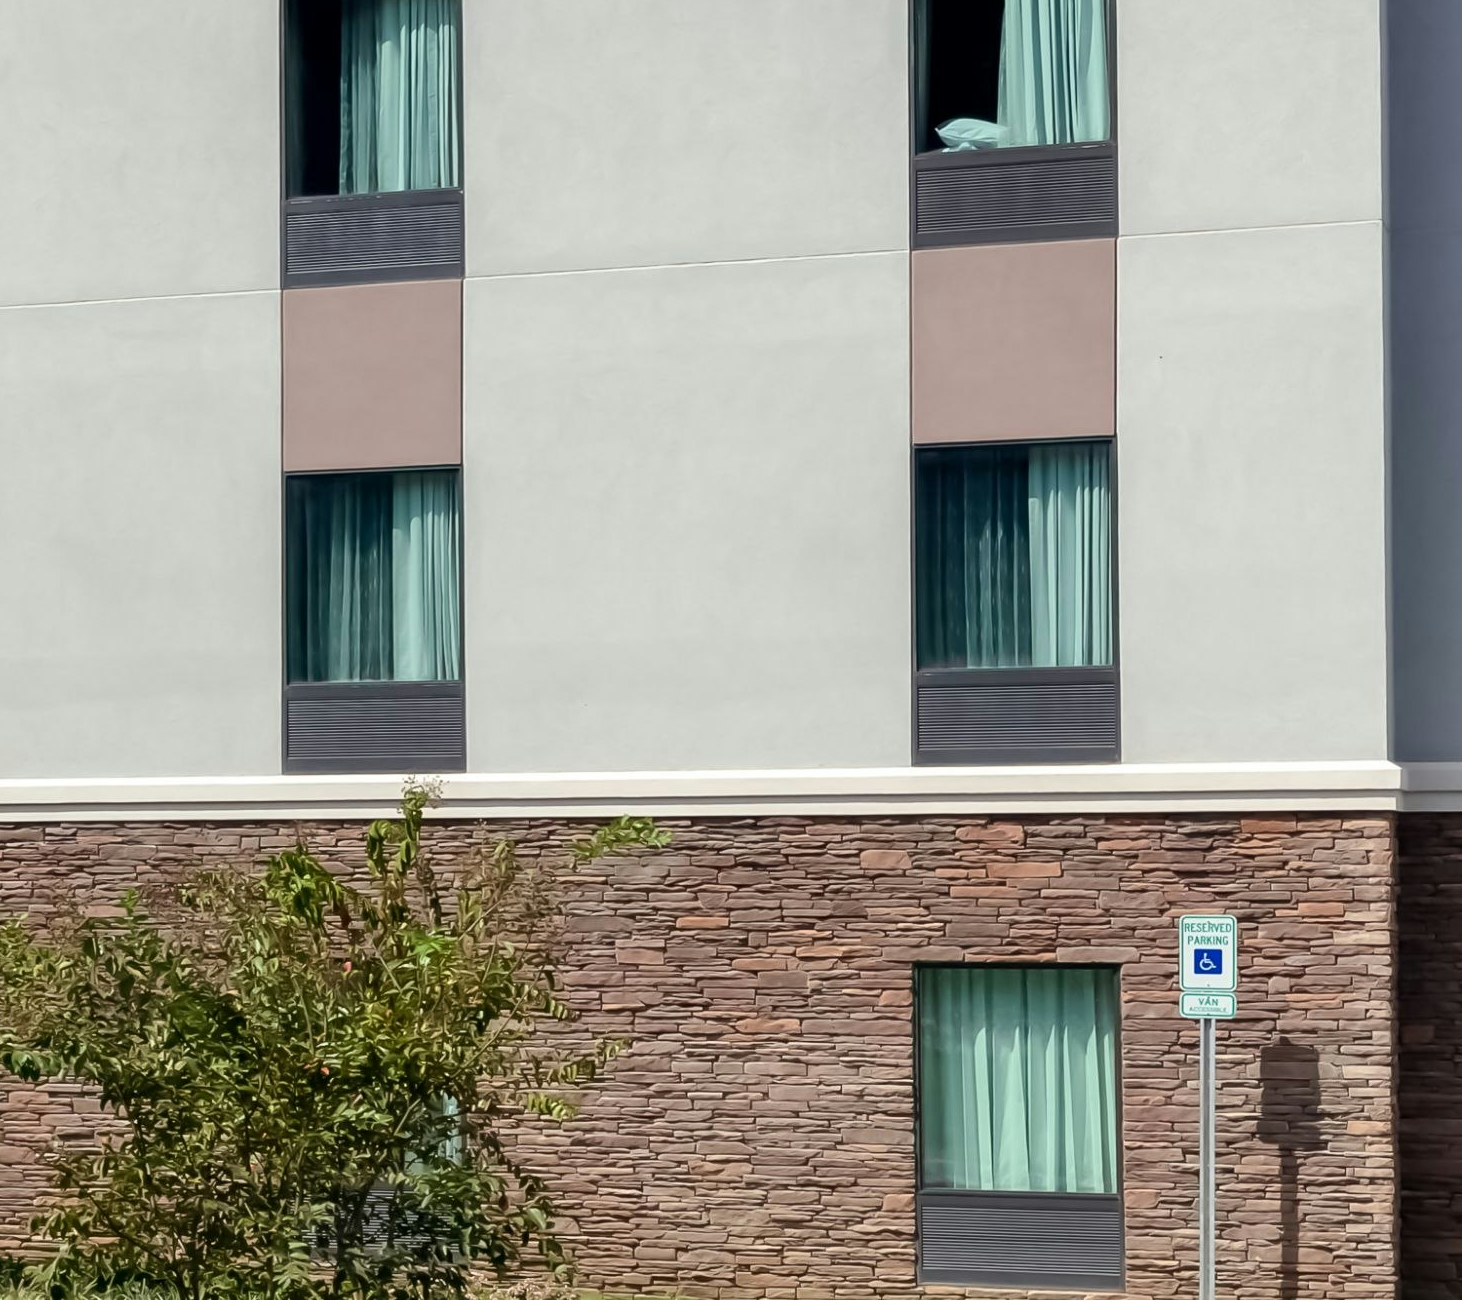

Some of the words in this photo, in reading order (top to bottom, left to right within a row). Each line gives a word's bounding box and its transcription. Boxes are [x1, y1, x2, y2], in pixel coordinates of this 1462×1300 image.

[1184, 922, 1232, 933] RESERVED
[1187, 936, 1229, 946] PARKING
[1198, 997, 1219, 1006] VAN
